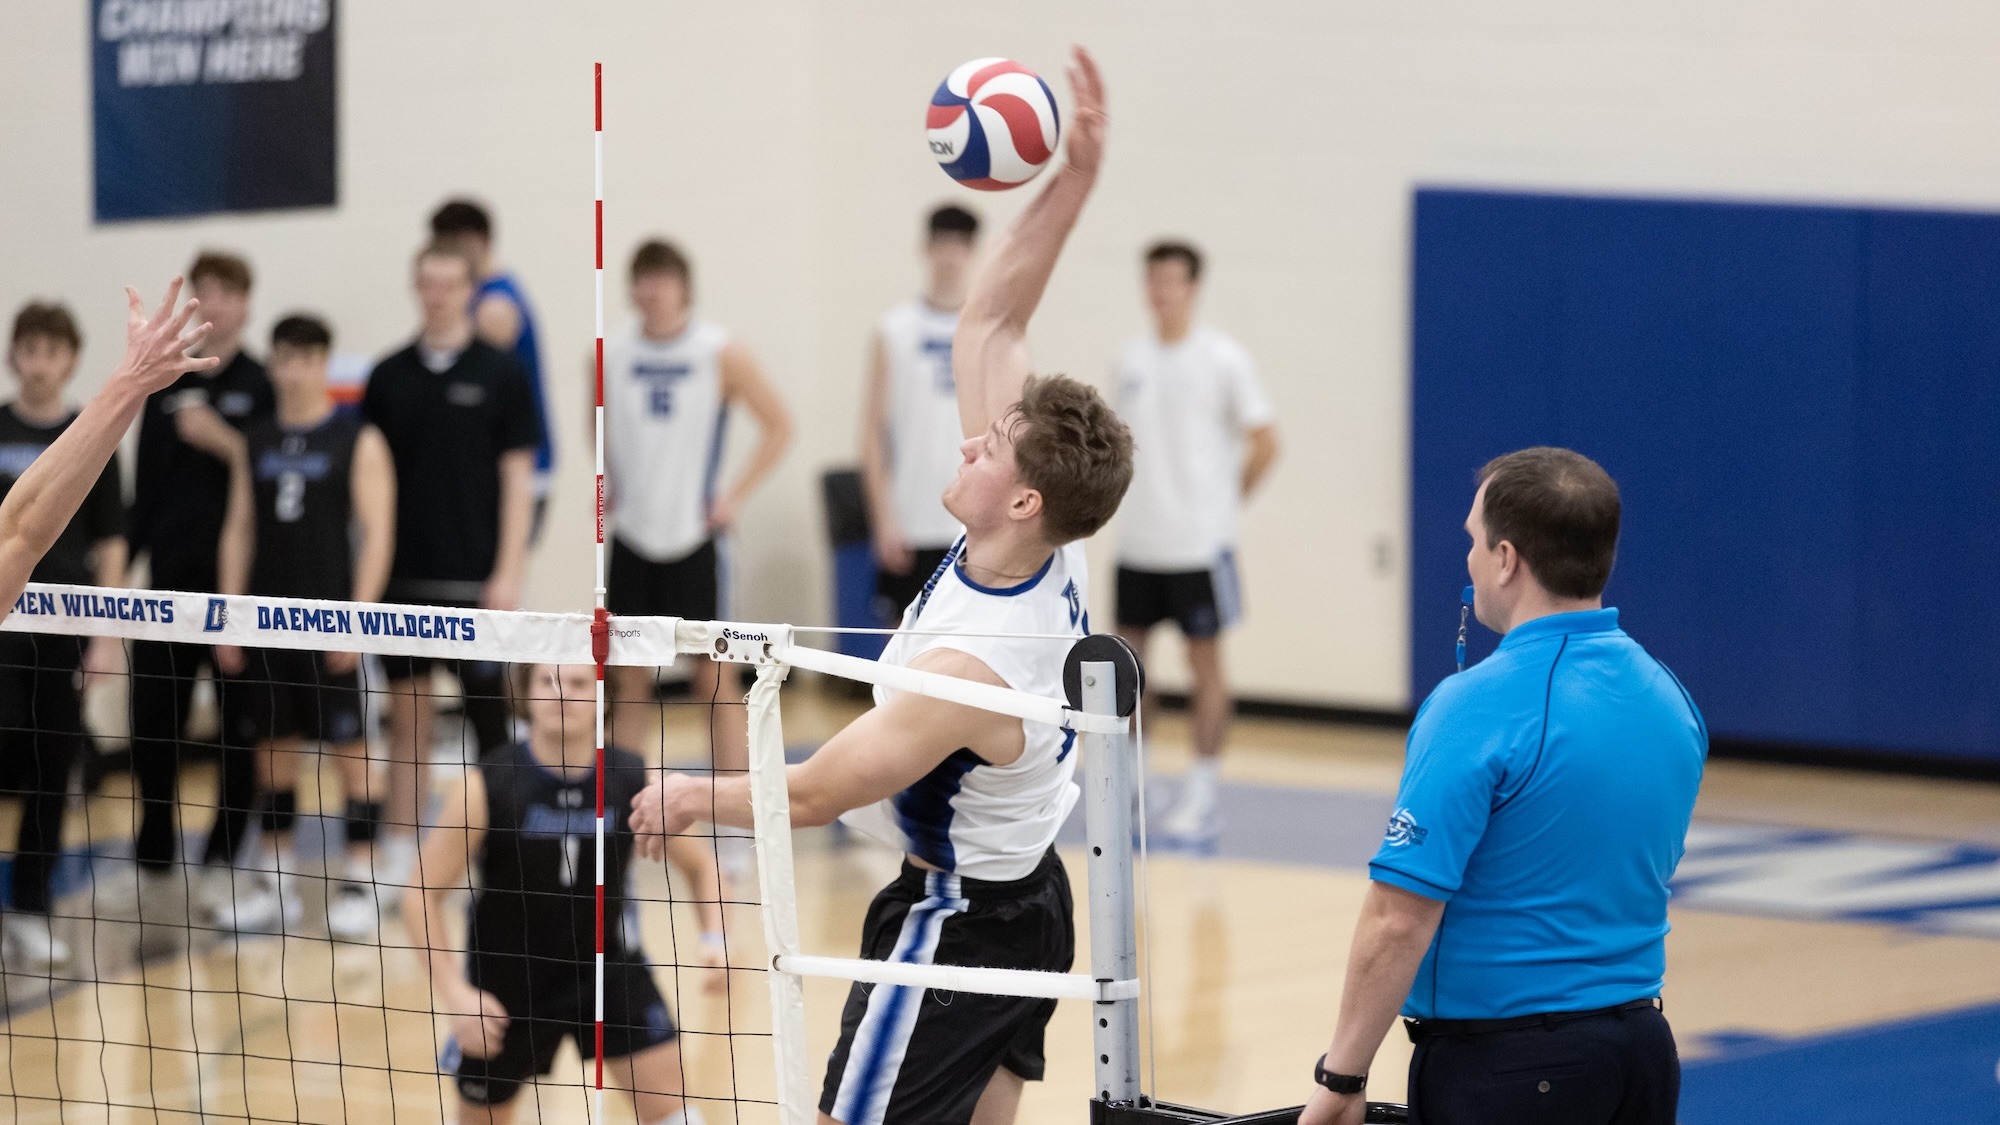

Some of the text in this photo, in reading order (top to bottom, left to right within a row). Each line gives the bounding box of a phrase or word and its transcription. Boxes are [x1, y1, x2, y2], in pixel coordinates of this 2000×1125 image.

[60, 593, 174, 623] WILDCATS
[257, 606, 475, 642] DAEMEN WILDCATS
[732, 630, 768, 642] Senoh
